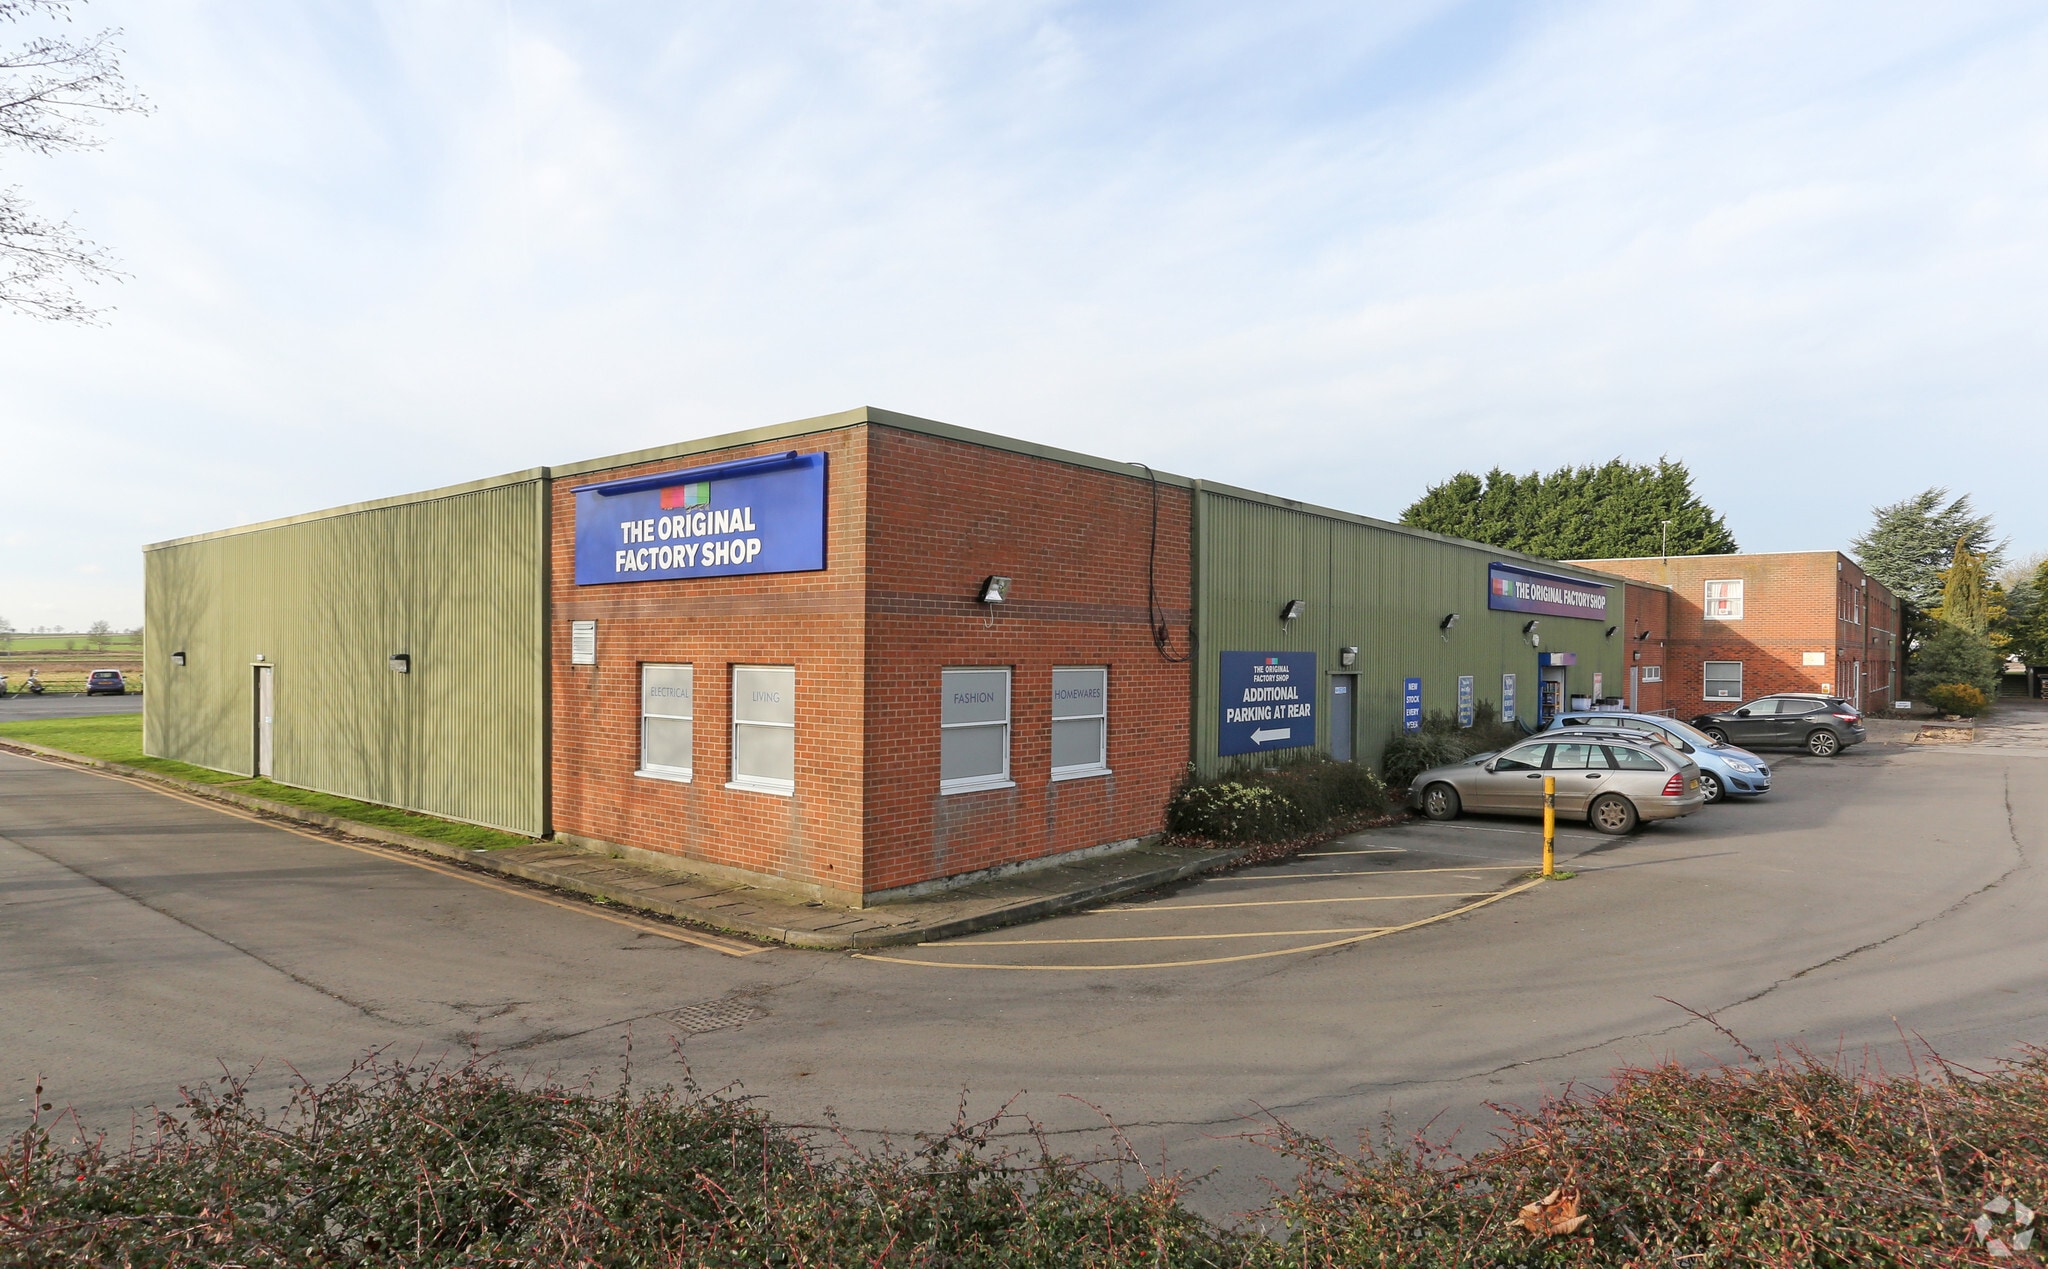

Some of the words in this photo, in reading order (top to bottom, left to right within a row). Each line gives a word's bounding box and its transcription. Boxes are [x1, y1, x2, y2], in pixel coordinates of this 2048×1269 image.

[621, 519, 655, 544] THE
[658, 507, 756, 540] ORIGINAL
[615, 544, 700, 573] FACTORY
[701, 538, 761, 567] SHOP
[1515, 581, 1530, 600] THE
[1530, 584, 1563, 604] ORIGINAL
[1563, 590, 1590, 608] FACTORY
[1590, 594, 1606, 610] SHOP
[1265, 665, 1289, 673] ORIGINAL
[1253, 674, 1276, 683] FACTORY
[1276, 674, 1289, 682] SHOP
[650, 686, 690, 699] ELECTRICAL
[1408, 682, 1419, 691] NEW
[752, 691, 781, 704] LIVING
[953, 691, 995, 705] FASHION
[1054, 687, 1101, 701] HOMEWARES
[1242, 686, 1298, 703] ADDITIONAL
[1406, 695, 1420, 704] STOCK
[1226, 706, 1272, 723] PARKING
[1273, 705, 1286, 719] AT
[1287, 703, 1311, 718] REAR
[1406, 708, 1420, 716] EVERY
